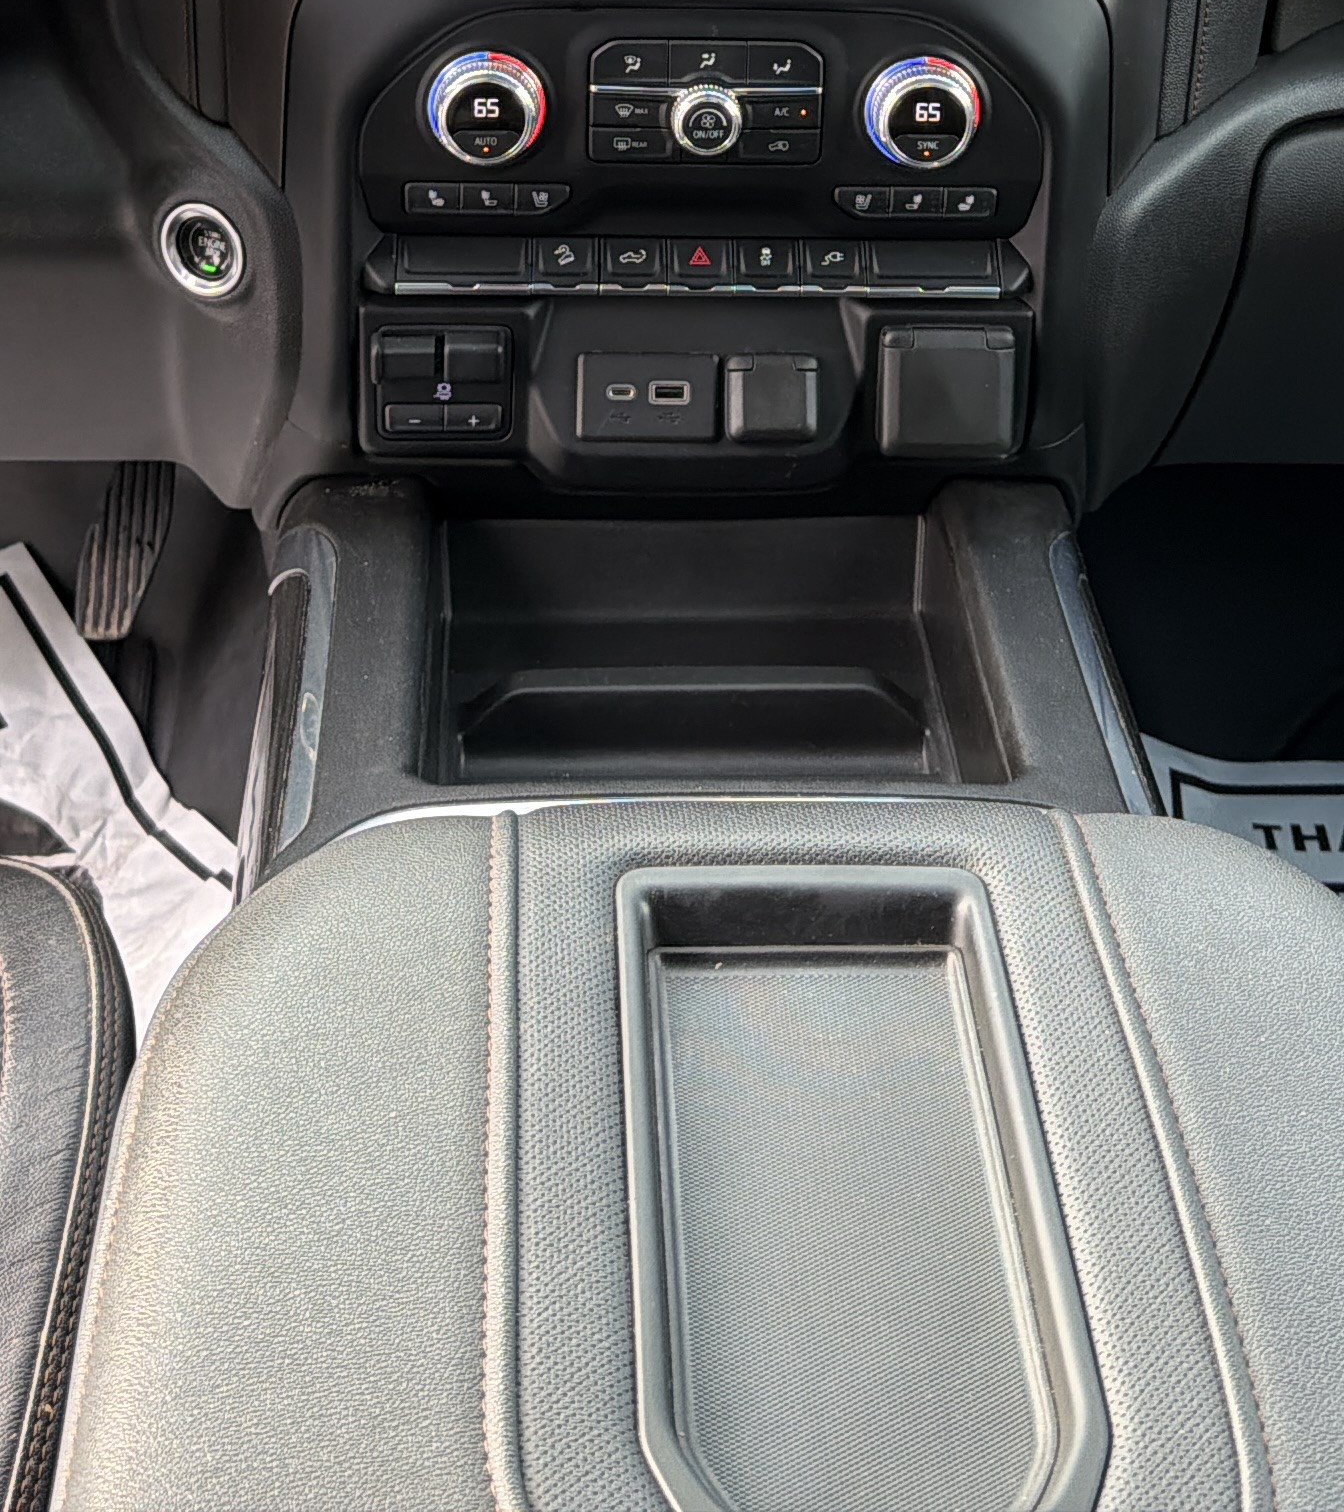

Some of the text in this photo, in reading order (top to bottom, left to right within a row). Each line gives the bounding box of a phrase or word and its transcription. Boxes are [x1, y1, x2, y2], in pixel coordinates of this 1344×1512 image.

[473, 98, 500, 118] 65
[774, 106, 790, 117] A/C
[915, 102, 941, 122] 65
[692, 129, 725, 139] ON/OFF
[474, 136, 498, 146] AUTO
[917, 140, 940, 150] SYNC
